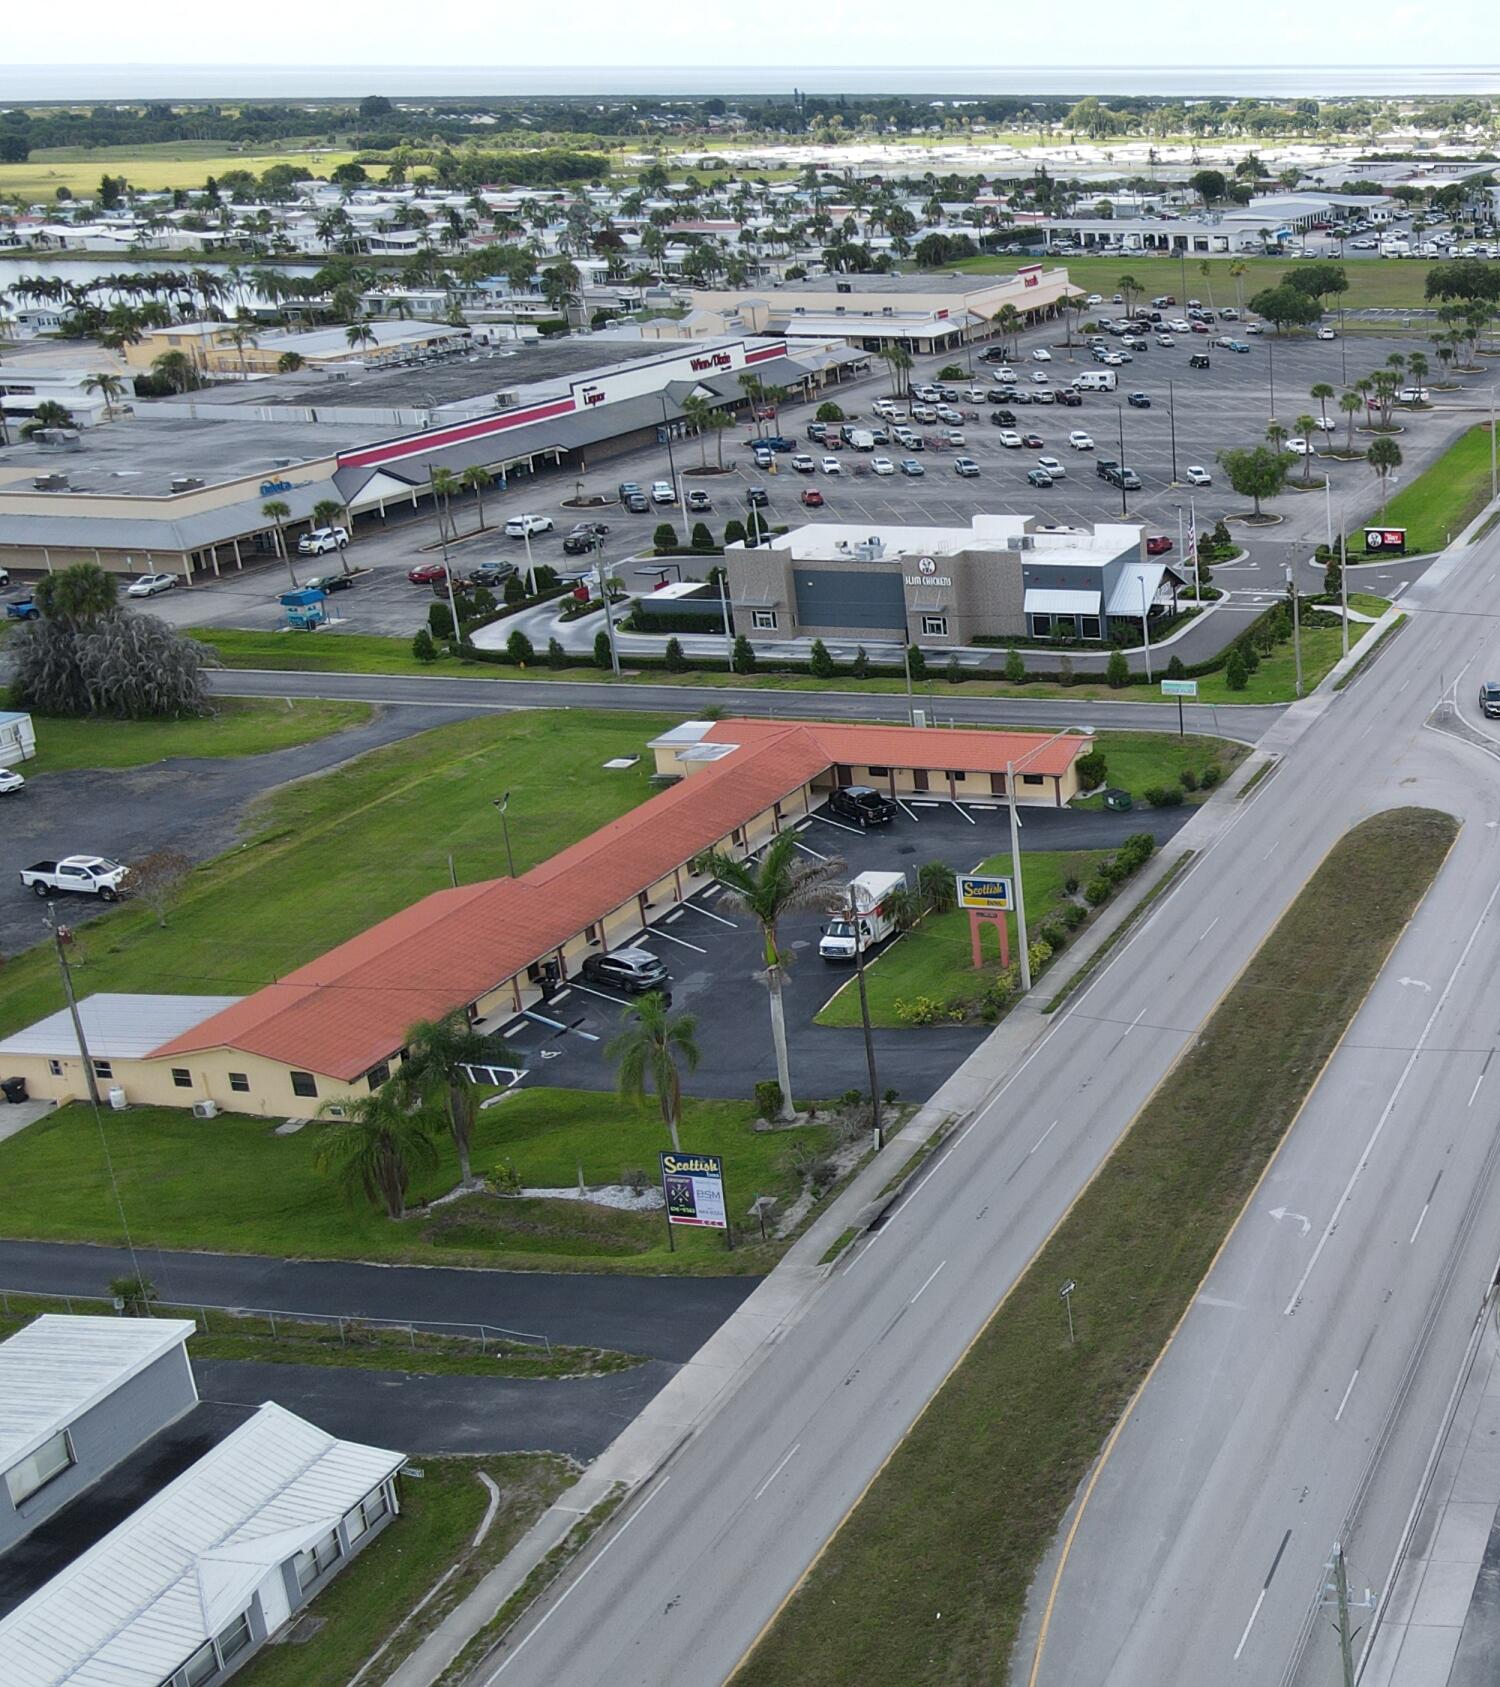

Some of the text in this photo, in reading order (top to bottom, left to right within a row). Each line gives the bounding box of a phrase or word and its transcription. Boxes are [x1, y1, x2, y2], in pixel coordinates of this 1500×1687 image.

[584, 392, 606, 407] Liquor
[963, 881, 1004, 897] Scottish
[664, 1156, 719, 1174] Scottish
